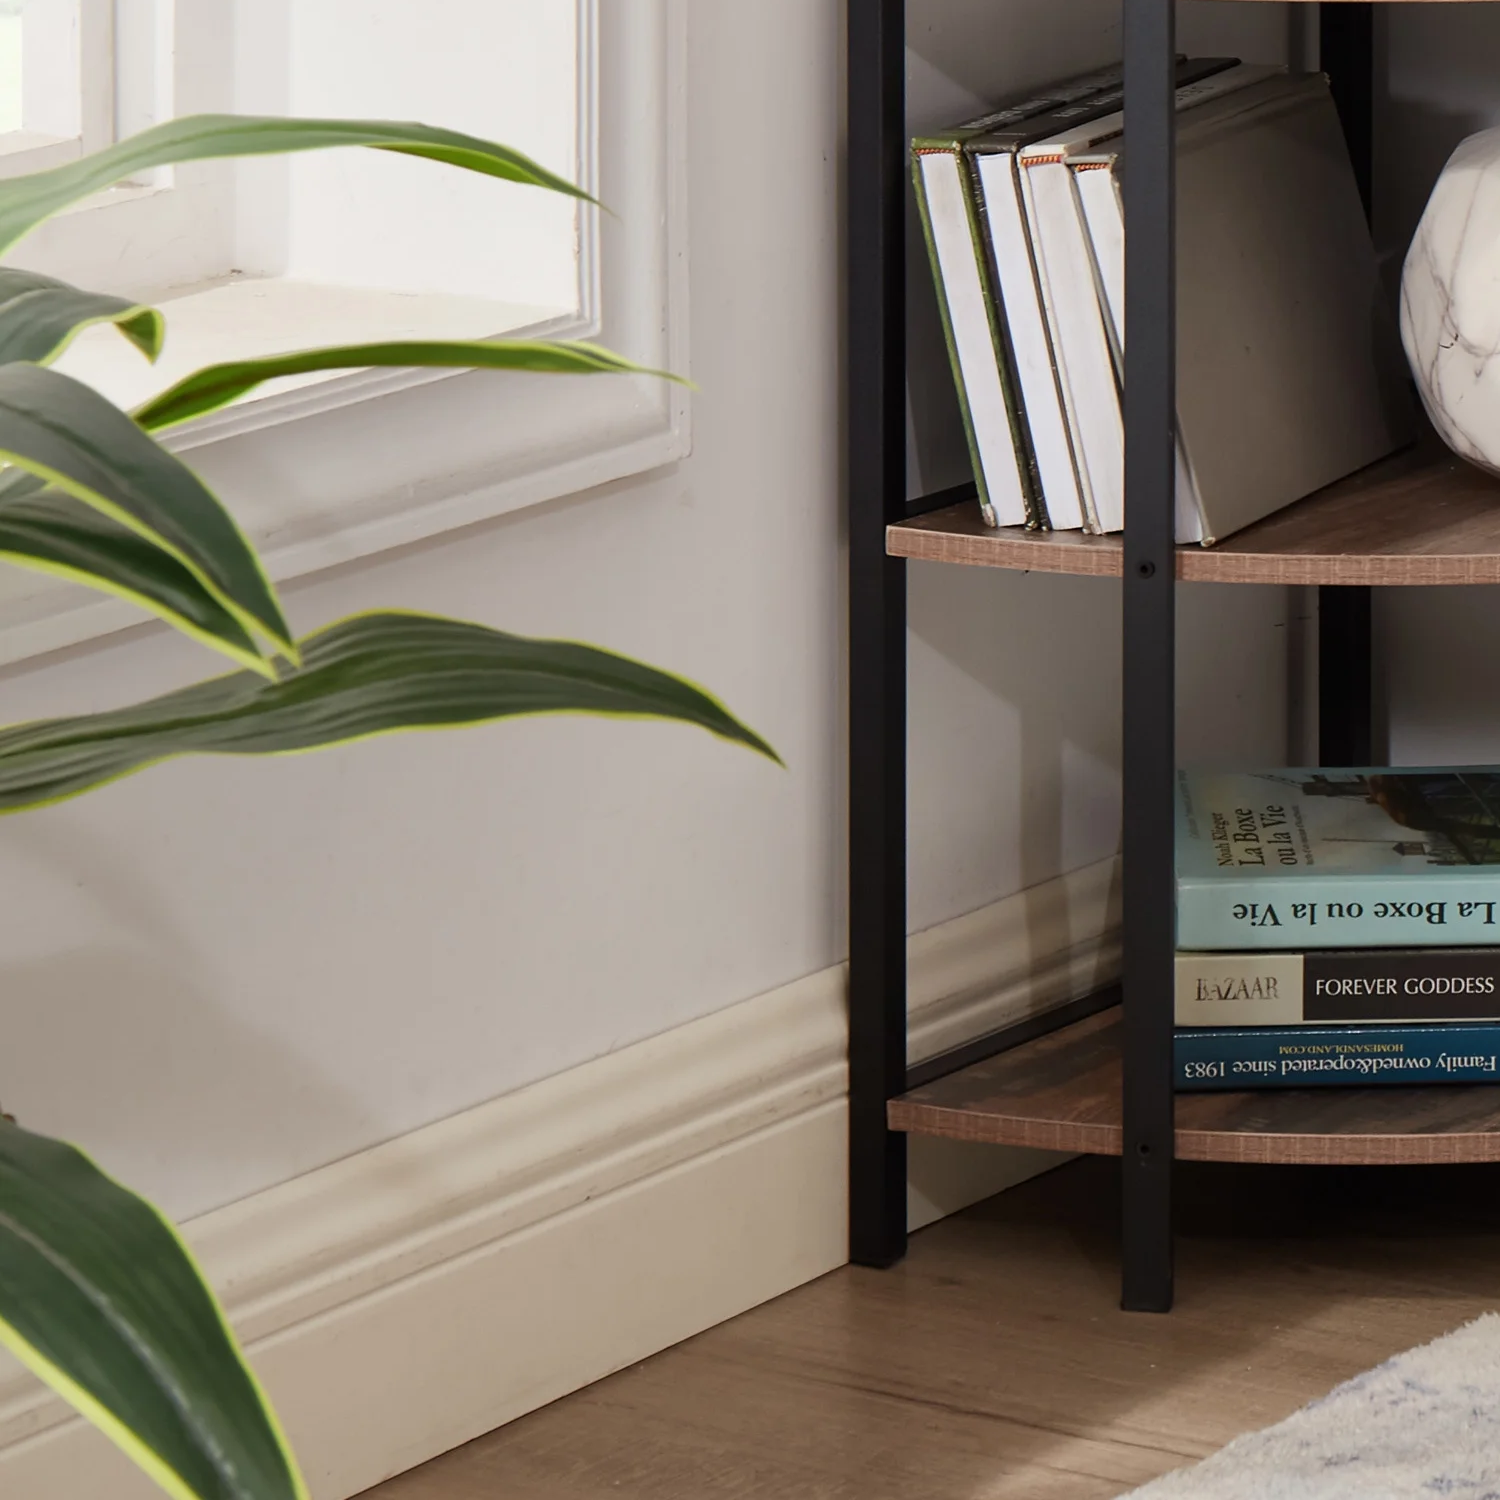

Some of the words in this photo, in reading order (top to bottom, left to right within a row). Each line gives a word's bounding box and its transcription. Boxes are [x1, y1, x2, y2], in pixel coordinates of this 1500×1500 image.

[1211, 812, 1229, 841] Klieger
[1233, 808, 1259, 843] Boxe
[1261, 804, 1287, 829] Vie
[1267, 831, 1292, 847] la
[1215, 843, 1234, 866] Noah
[1238, 846, 1265, 866] La
[1277, 849, 1297, 865] ou
[1233, 903, 1282, 927] Vie
[1291, 903, 1317, 925] la
[1327, 903, 1363, 918] ou
[1374, 901, 1447, 925] Boxe
[1457, 902, 1497, 924] La
[1195, 976, 1278, 1001] BAZAAR
[1315, 978, 1397, 996] FOREVER
[1404, 976, 1495, 994] GODDESS
[1279, 1043, 1404, 1055] HOMESANDLAND.COM
[1184, 1062, 1225, 1079] 1983
[1232, 1061, 1277, 1077] since
[1282, 1055, 1431, 1077] owned&operated
[1434, 1053, 1497, 1073] Family
